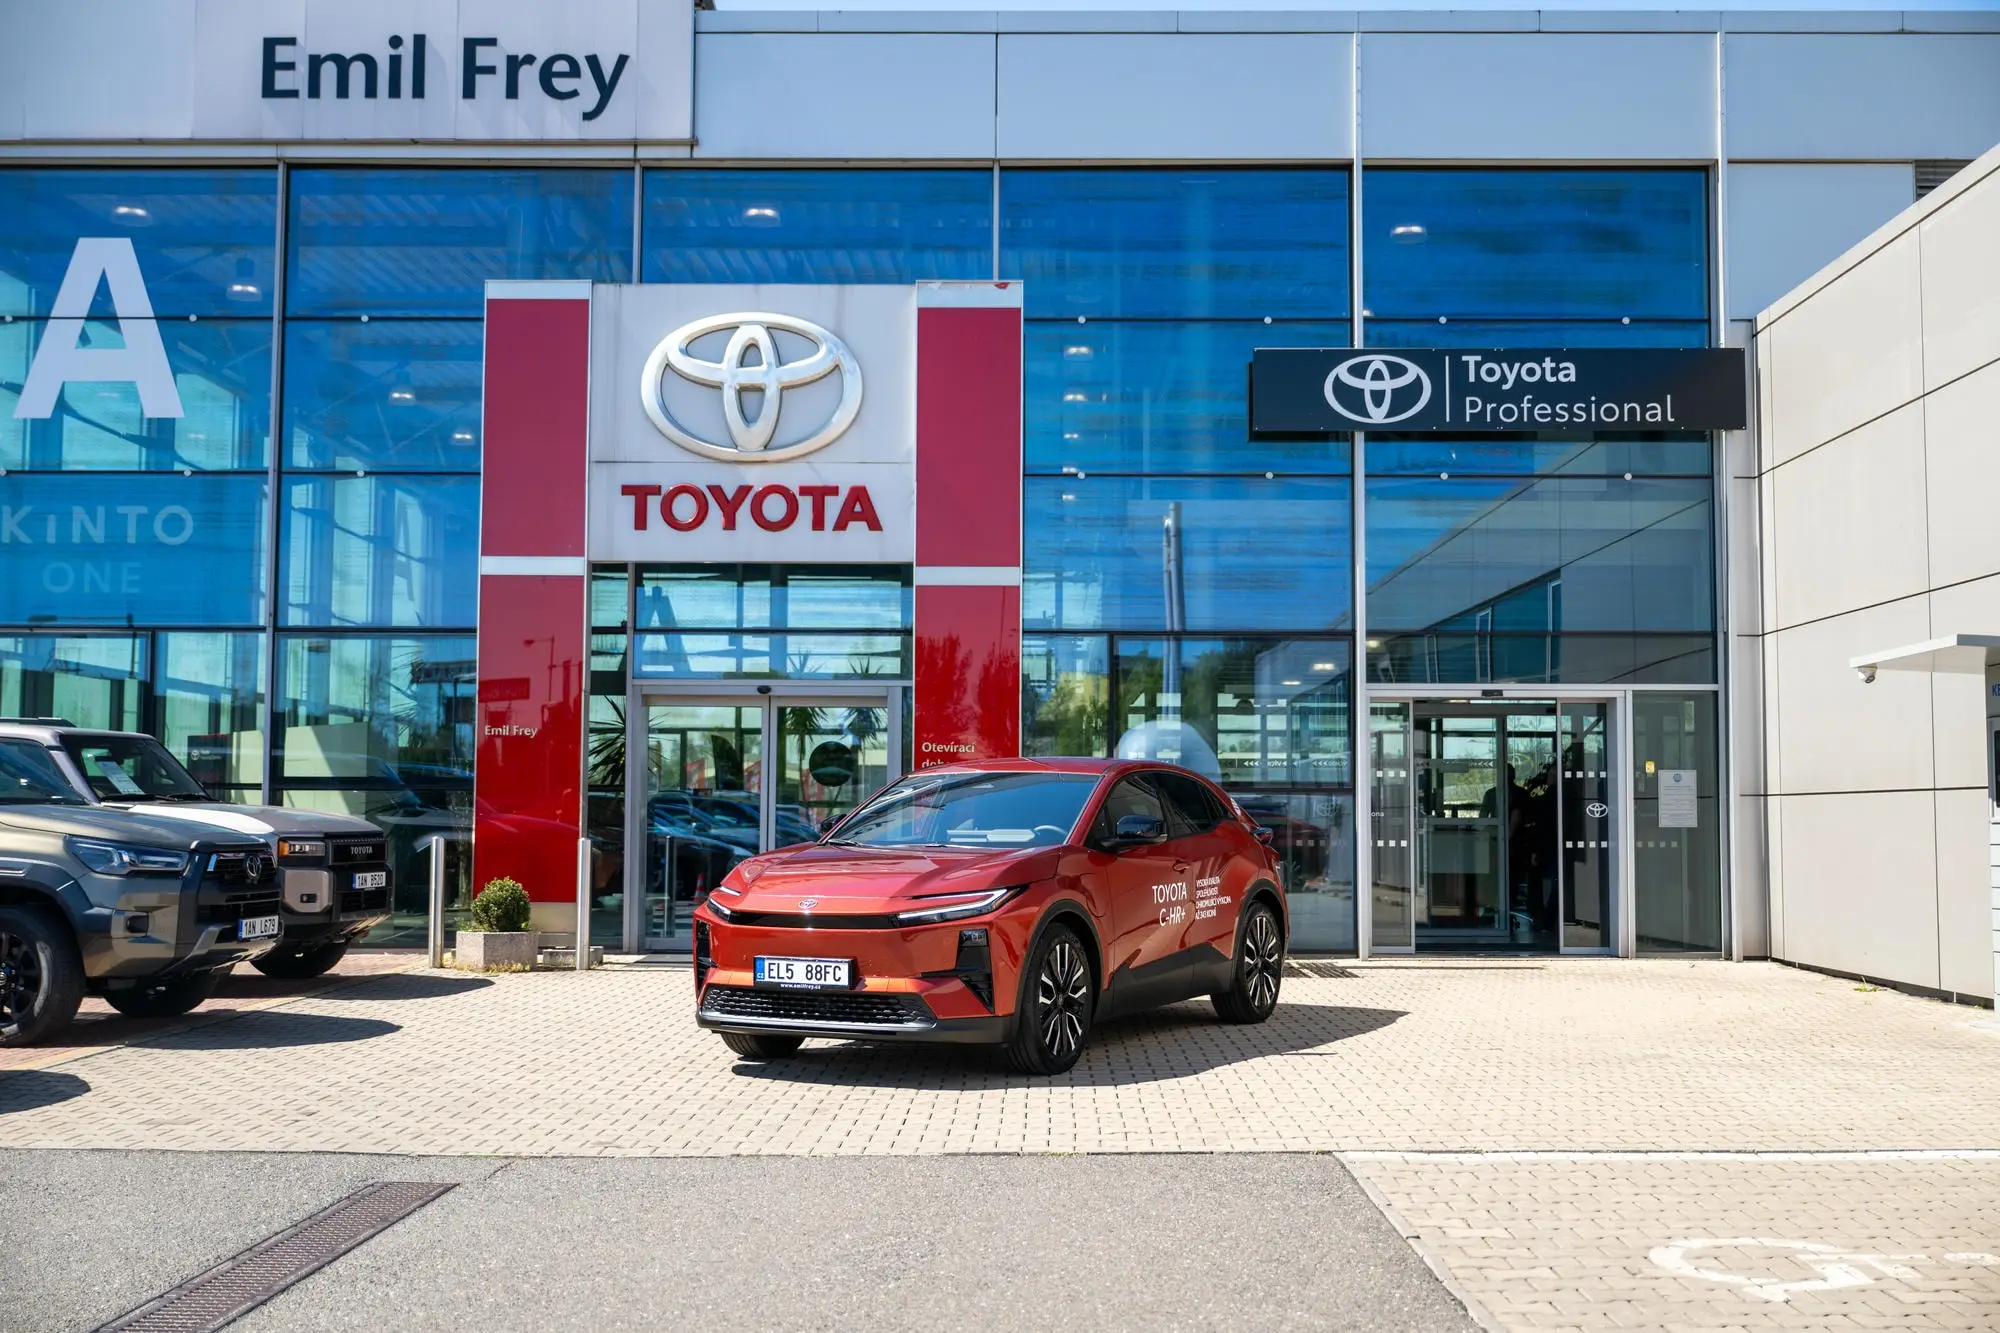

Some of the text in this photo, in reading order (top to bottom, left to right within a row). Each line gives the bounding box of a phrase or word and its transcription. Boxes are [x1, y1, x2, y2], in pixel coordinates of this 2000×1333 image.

[261, 34, 630, 121] Emil Frey
[13, 237, 185, 418] A
[1461, 354, 1576, 389] Toyota
[1465, 395, 1675, 423] Professional
[621, 483, 883, 532] TOYOTA
[43, 561, 142, 593] ONE
[484, 725, 538, 739] Emil Frey
[921, 741, 975, 753] Otevírací
[350, 846, 373, 854] TOYOTA
[1152, 882, 1187, 904] TOYOTA
[245, 918, 275, 936] 1AN L679
[1160, 906, 1186, 926] C-HR+
[768, 962, 841, 982] EL5 88FC
